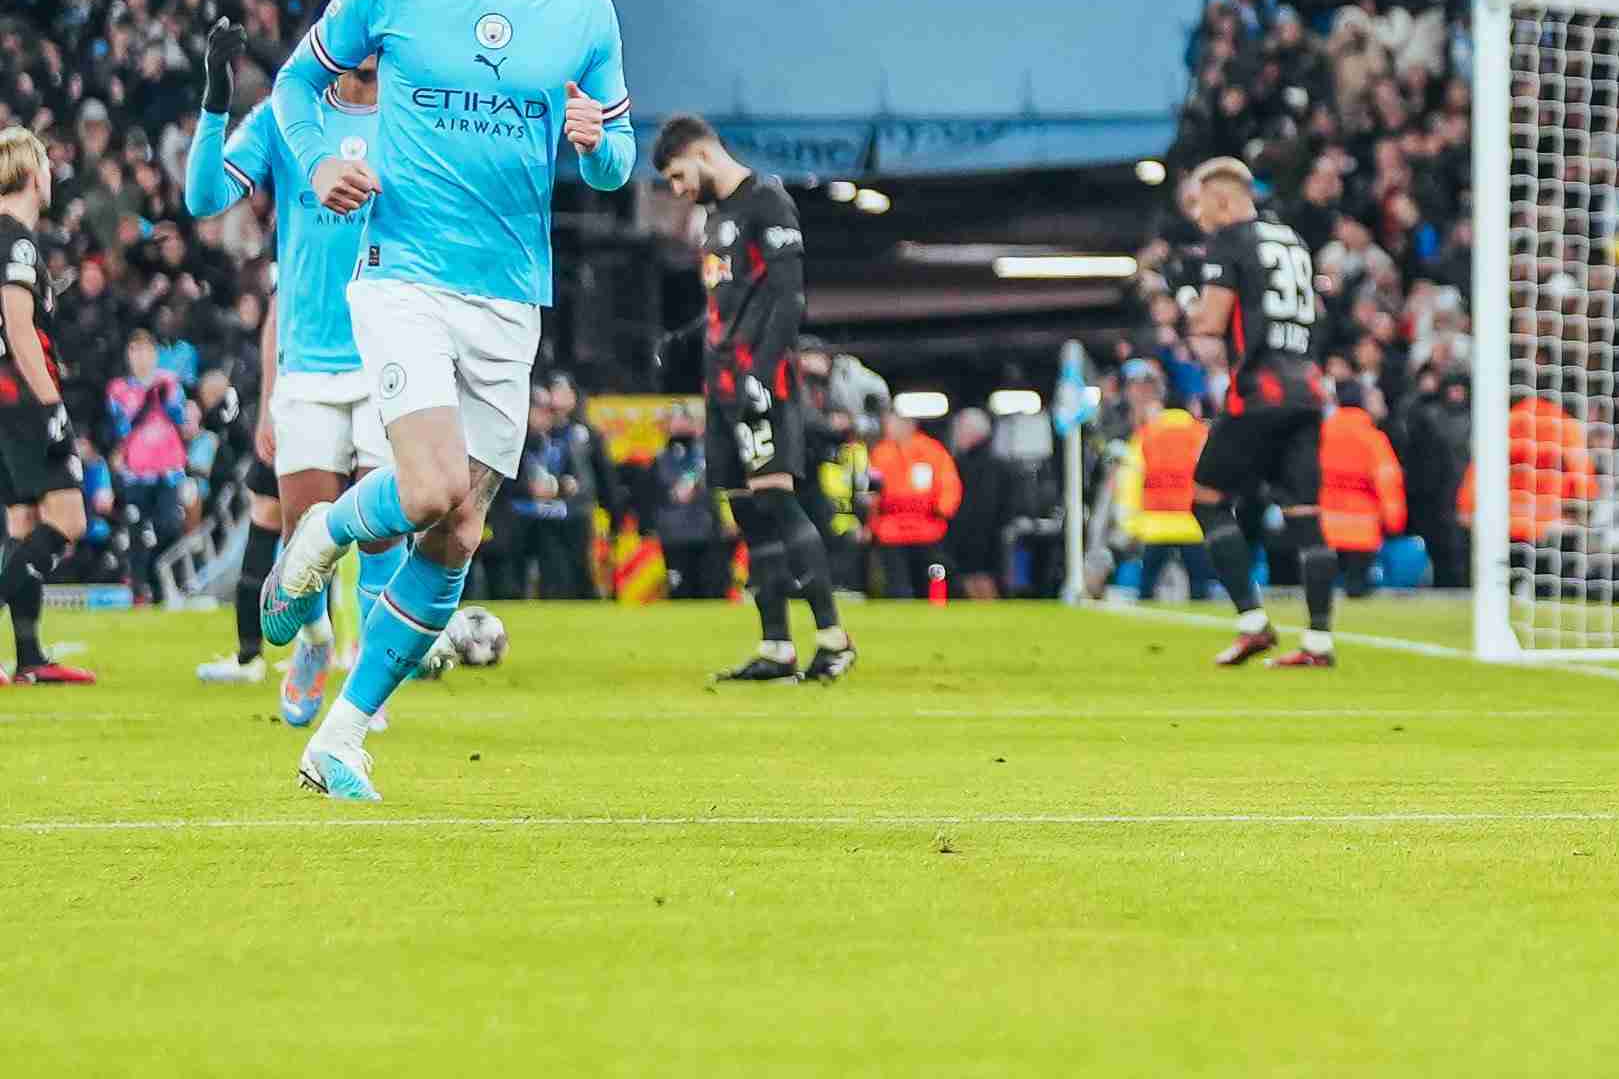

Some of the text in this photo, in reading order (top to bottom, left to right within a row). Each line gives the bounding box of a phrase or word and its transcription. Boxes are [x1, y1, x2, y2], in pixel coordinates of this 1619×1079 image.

[412, 87, 548, 119] ETIHAD
[434, 117, 525, 138] AIRWAYS
[315, 213, 365, 224] AIRWA
[1256, 241, 1316, 323] 39
